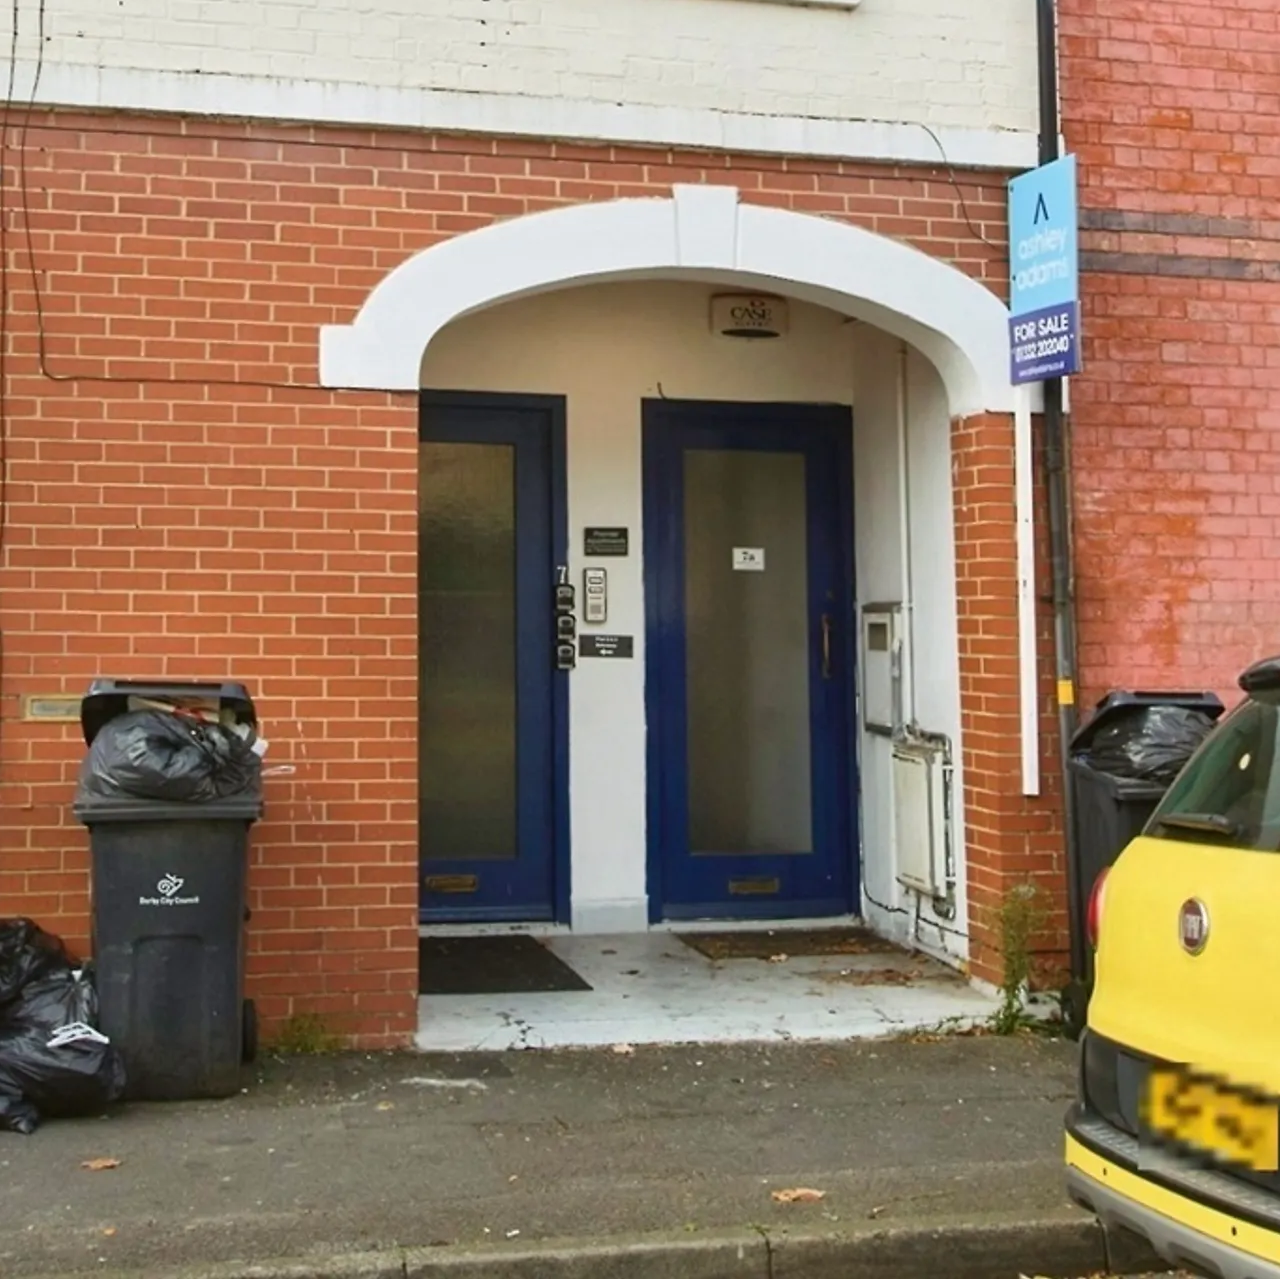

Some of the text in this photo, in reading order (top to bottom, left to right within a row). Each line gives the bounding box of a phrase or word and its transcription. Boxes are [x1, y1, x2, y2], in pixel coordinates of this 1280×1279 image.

[1018, 226, 1068, 259] ashley
[1017, 255, 1068, 291] adams
[730, 307, 773, 320] CASE
[1014, 313, 1069, 343] FOR SALE
[557, 566, 566, 584] 7
[139, 895, 200, 906] Derby City Council
